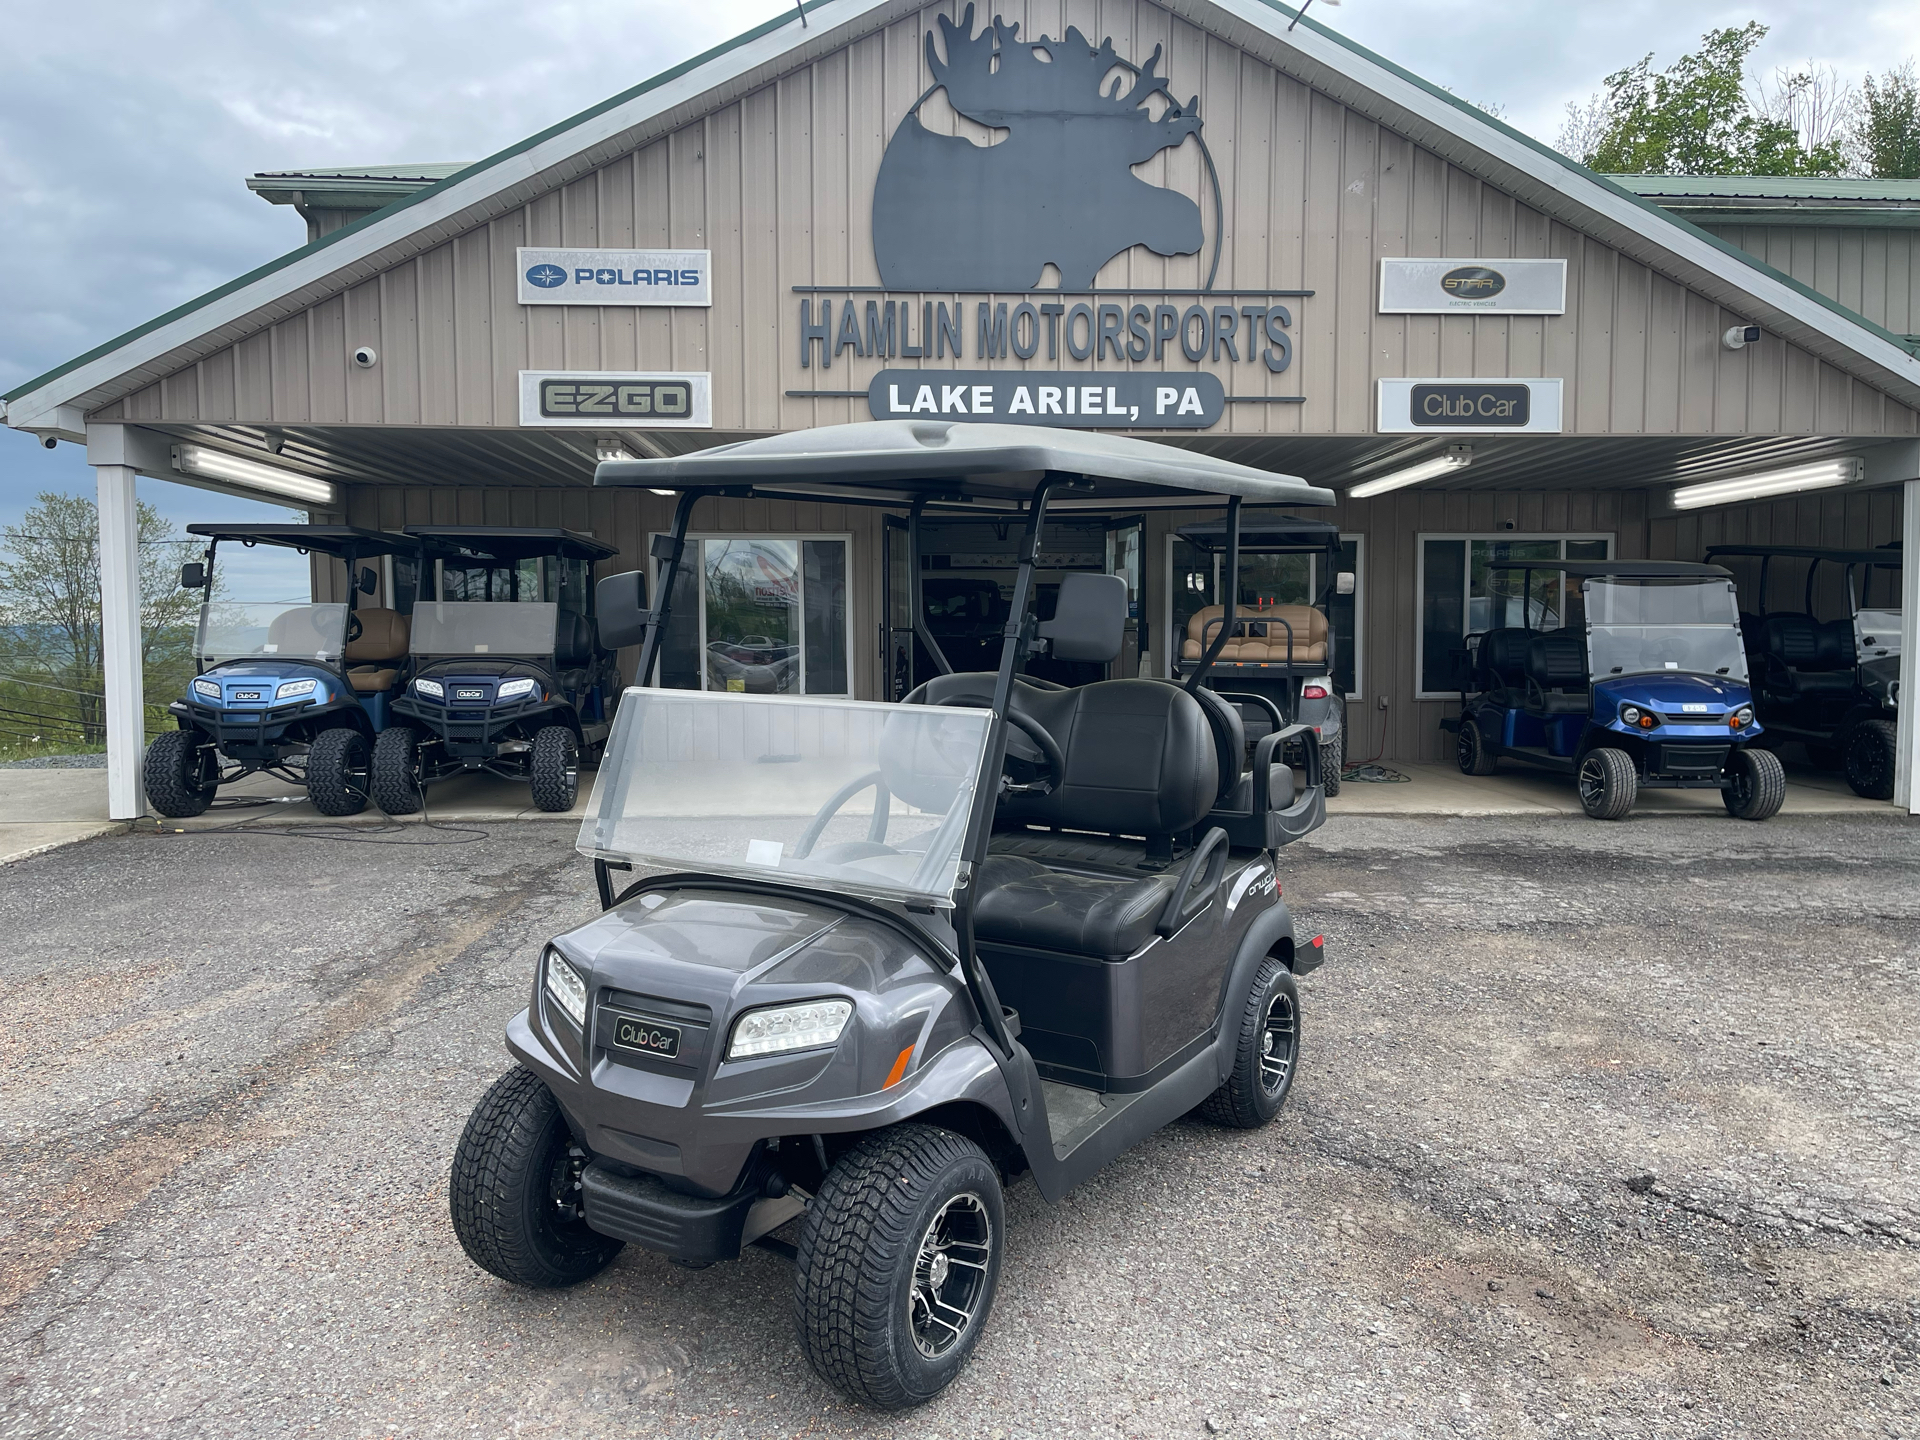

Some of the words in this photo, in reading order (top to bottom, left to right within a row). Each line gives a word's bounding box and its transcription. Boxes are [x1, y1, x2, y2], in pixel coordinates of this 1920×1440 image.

[574, 268, 700, 286] POLARIS
[1445, 279, 1493, 288] STAR
[800, 298, 963, 368] HAMLIN
[977, 301, 1293, 373] MOTORSPORTS
[545, 385, 687, 413] EZGO
[888, 384, 995, 414] LAKE
[1007, 385, 1140, 422] ARIEL,
[1155, 386, 1205, 416] PA
[1423, 393, 1475, 417] Club
[1477, 393, 1518, 417] Car
[620, 1024, 648, 1045] Club
[649, 1030, 673, 1050] Car
